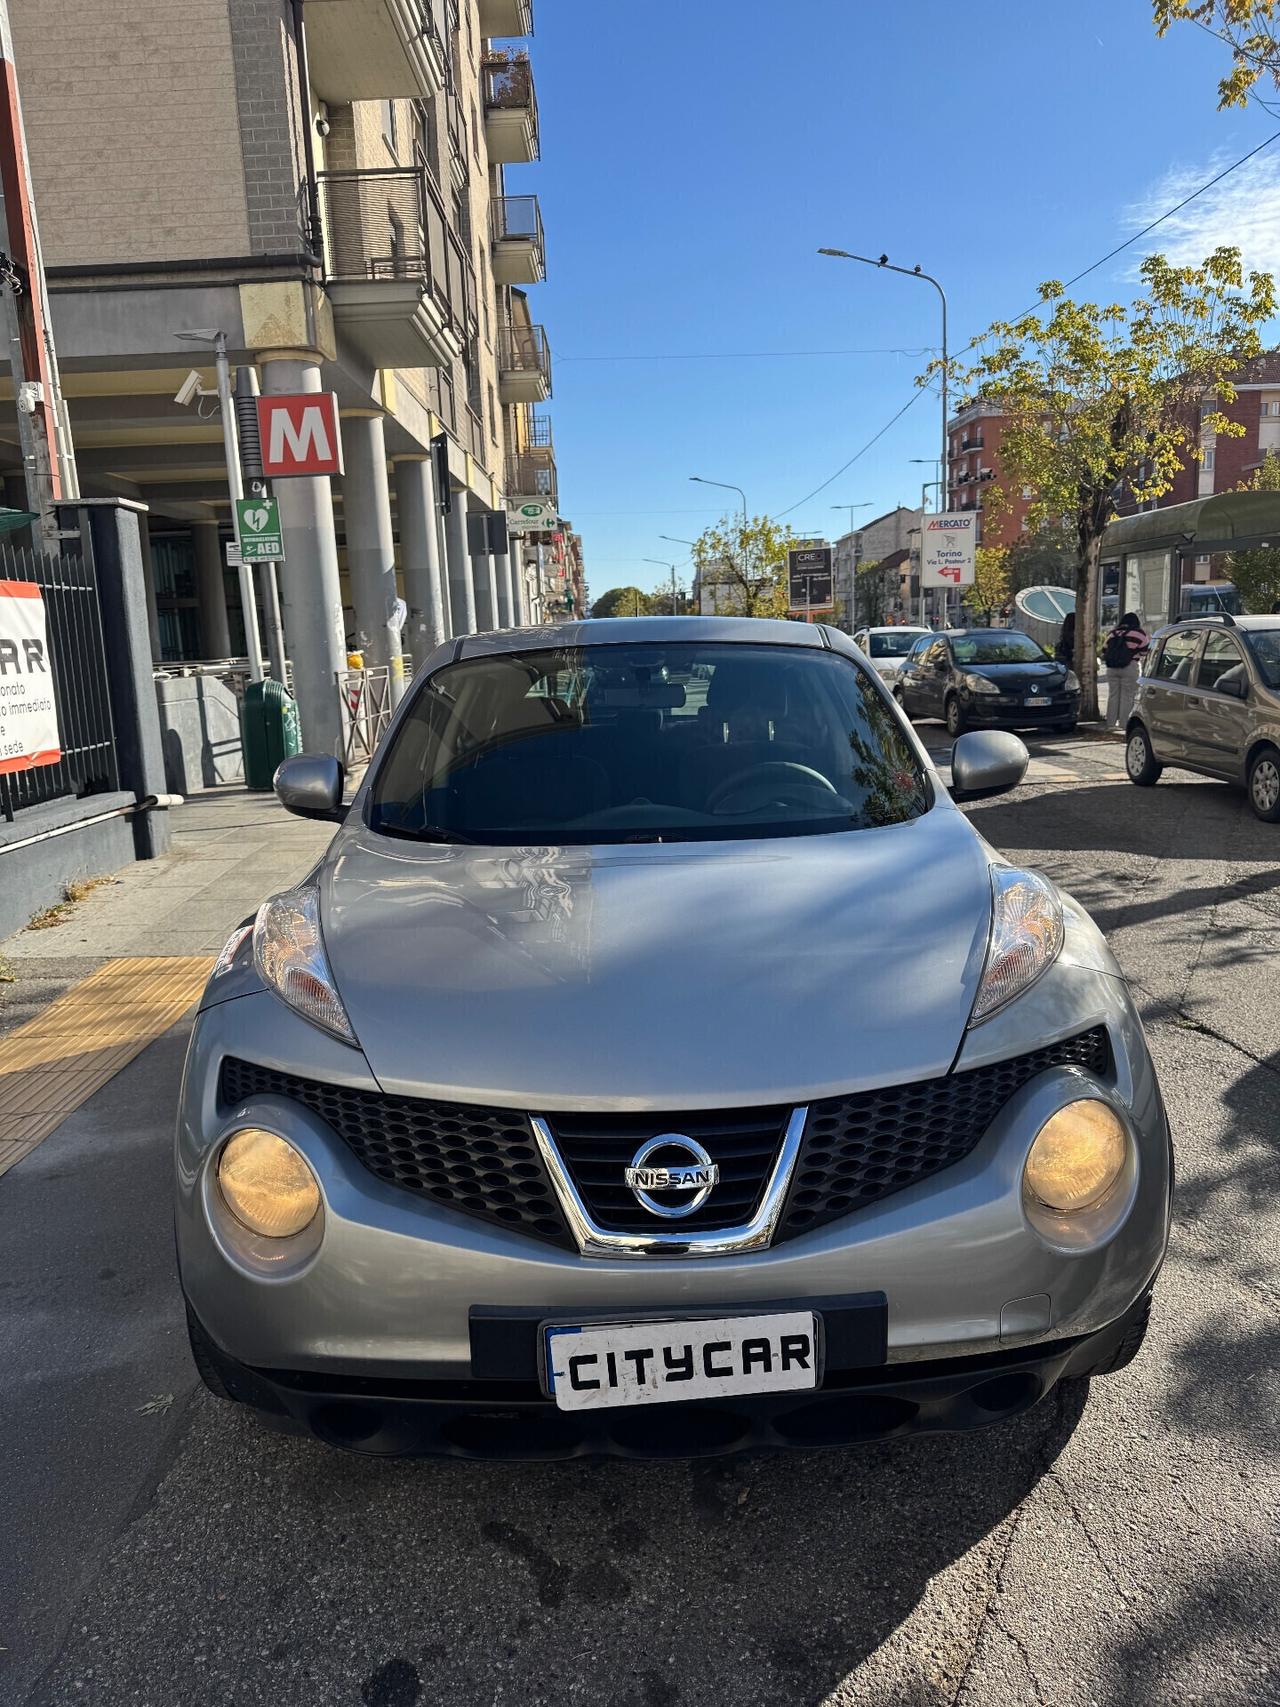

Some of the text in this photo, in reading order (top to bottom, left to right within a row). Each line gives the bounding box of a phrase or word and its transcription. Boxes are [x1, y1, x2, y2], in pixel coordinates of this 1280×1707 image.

[268, 406, 333, 463] M
[257, 542, 280, 555] AED
[936, 549, 962, 558] Torino
[8, 698, 52, 715] immediato
[4, 740, 24, 756] sede
[634, 1170, 710, 1187] NISSAN
[568, 1333, 811, 1391] CITYCAR
